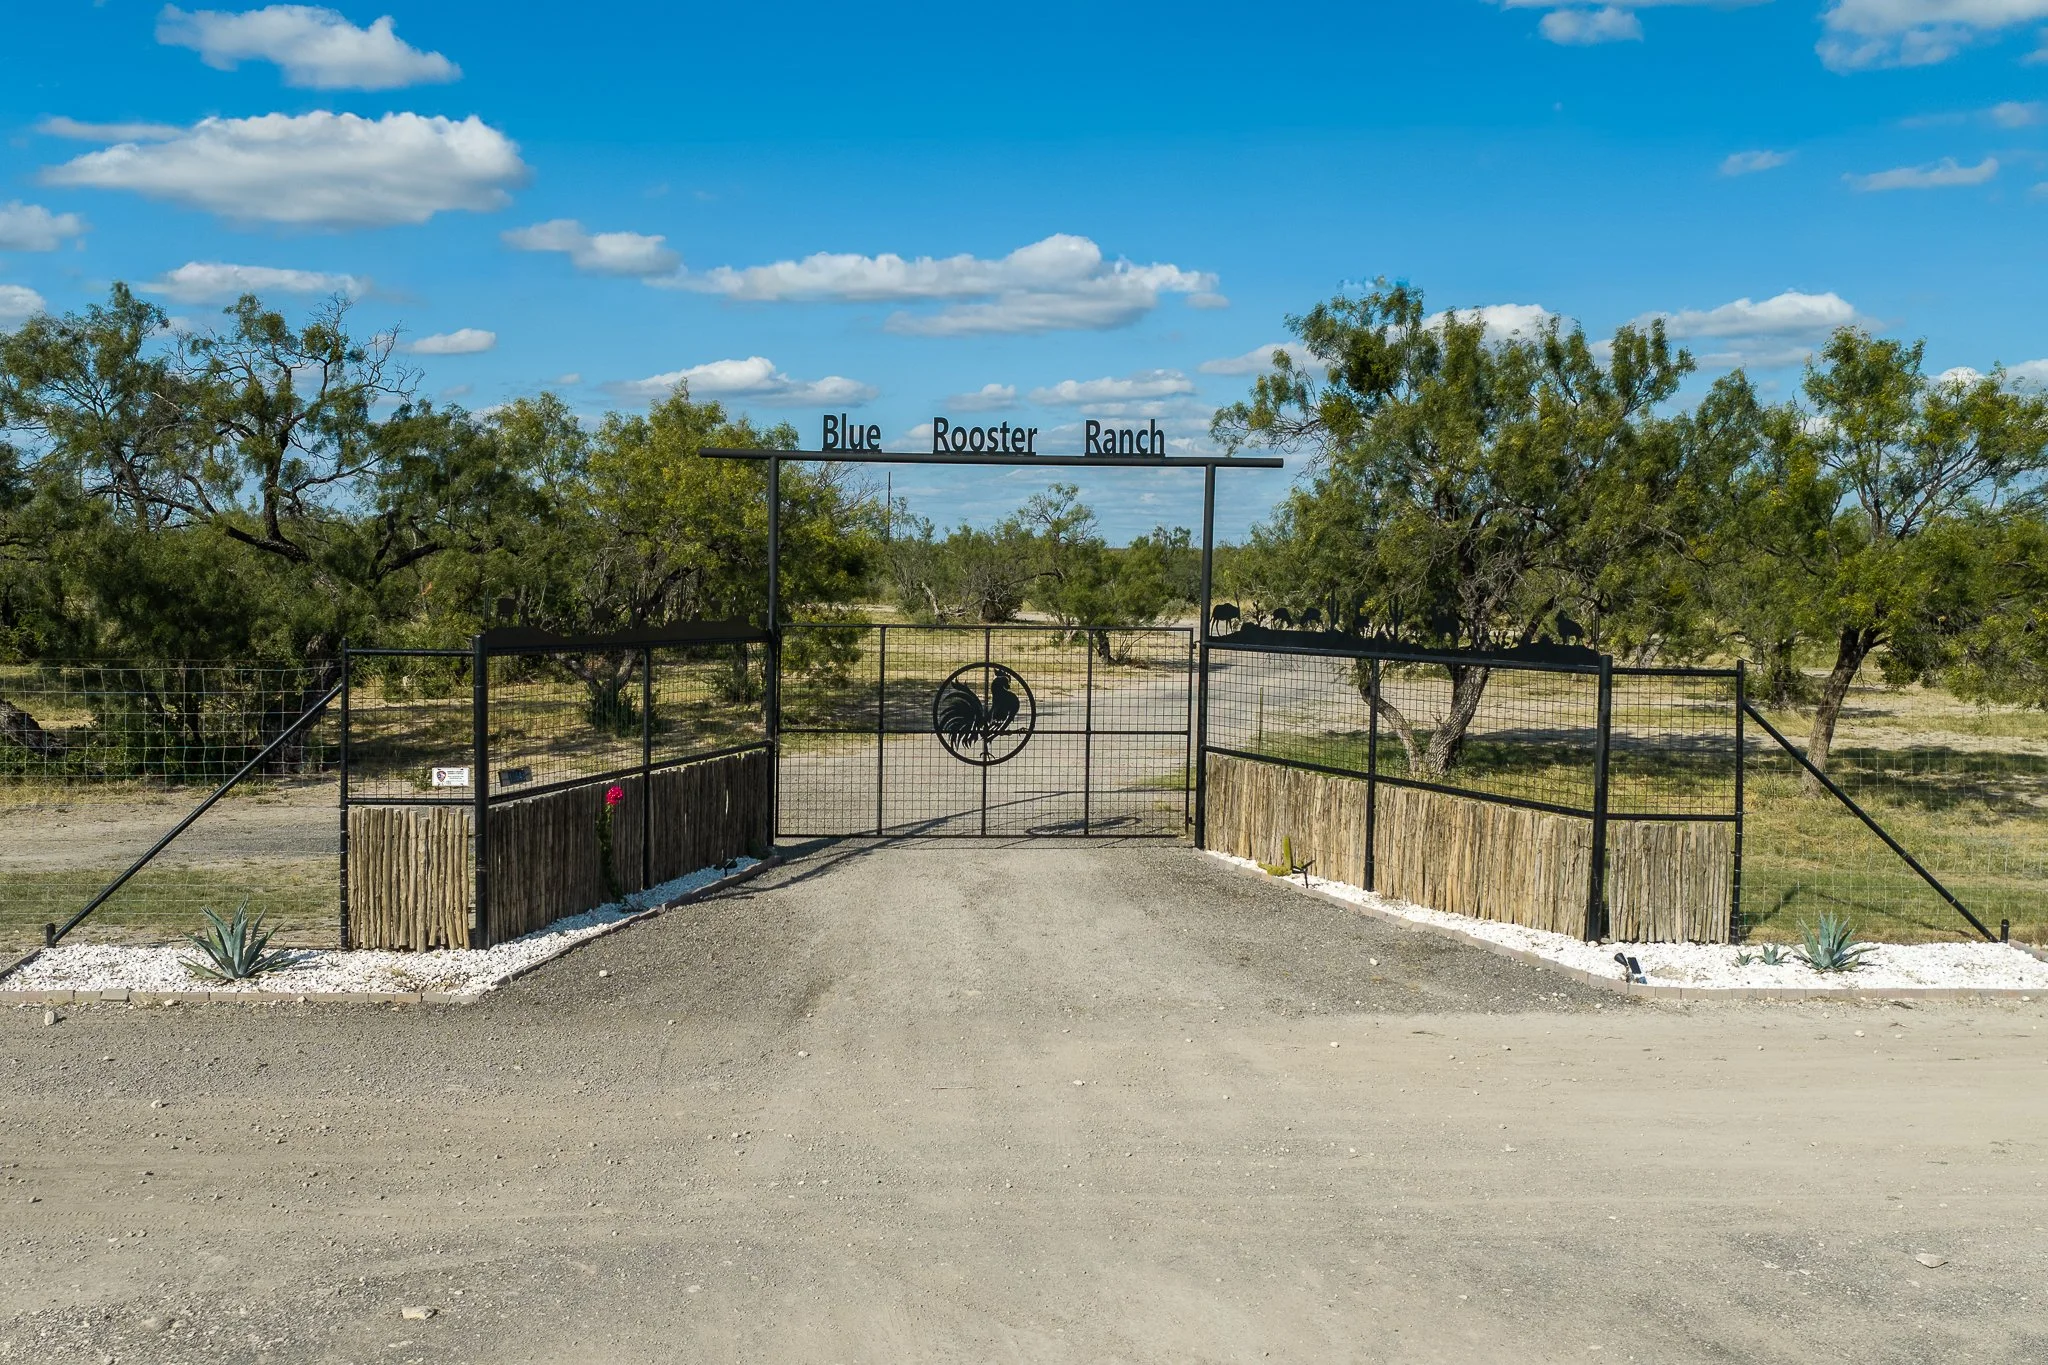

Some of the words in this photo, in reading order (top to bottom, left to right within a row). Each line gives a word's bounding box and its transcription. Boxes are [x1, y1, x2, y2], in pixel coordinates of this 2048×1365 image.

[823, 413, 881, 450] Blue
[934, 417, 1037, 453] Rooster
[1086, 419, 1164, 454] Ranch
